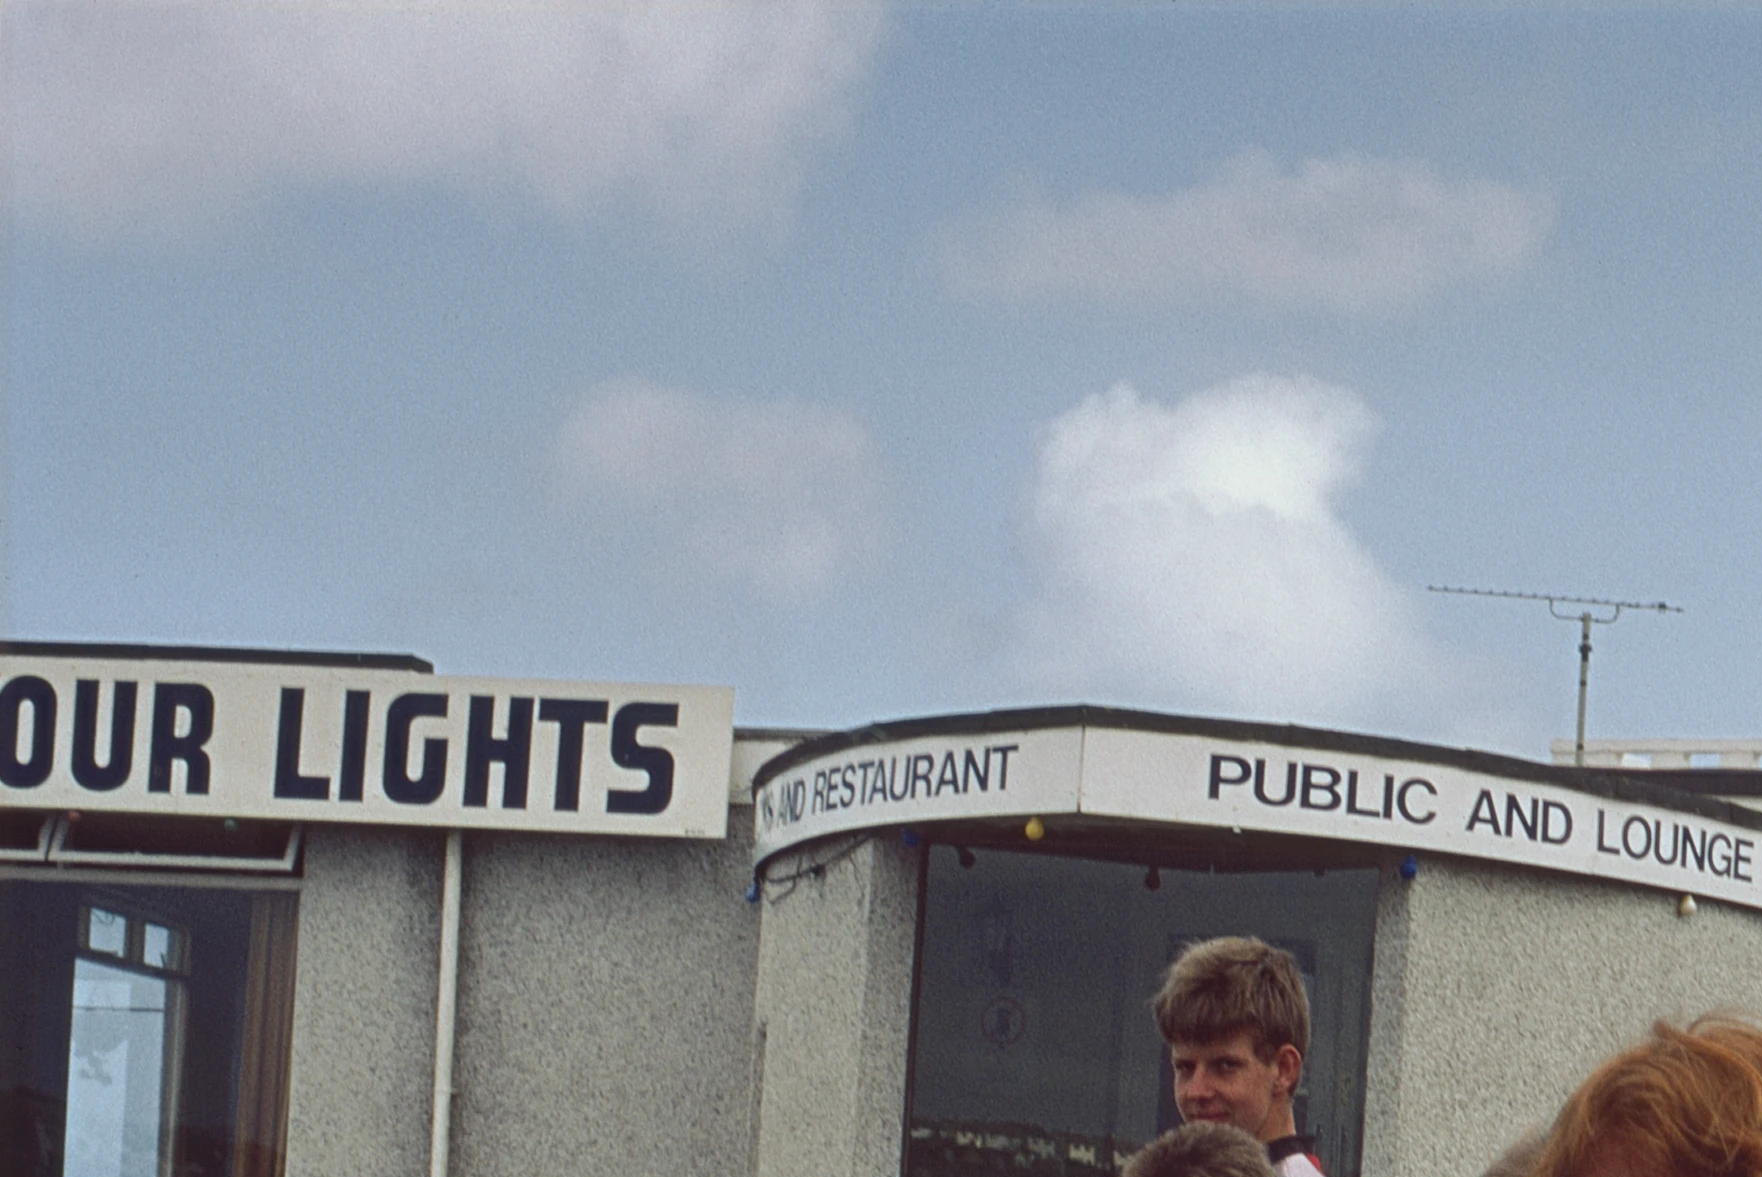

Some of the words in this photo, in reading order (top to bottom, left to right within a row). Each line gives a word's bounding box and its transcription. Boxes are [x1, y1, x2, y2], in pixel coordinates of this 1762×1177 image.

[0, 675, 215, 795] OUR
[273, 687, 679, 815] LIGHTS
[778, 776, 806, 826] AND
[812, 744, 1020, 813] RESTAURANT
[1207, 754, 1437, 825] PUBLIC
[1466, 789, 1573, 846] AND
[1597, 809, 1754, 883] LOUNGE
